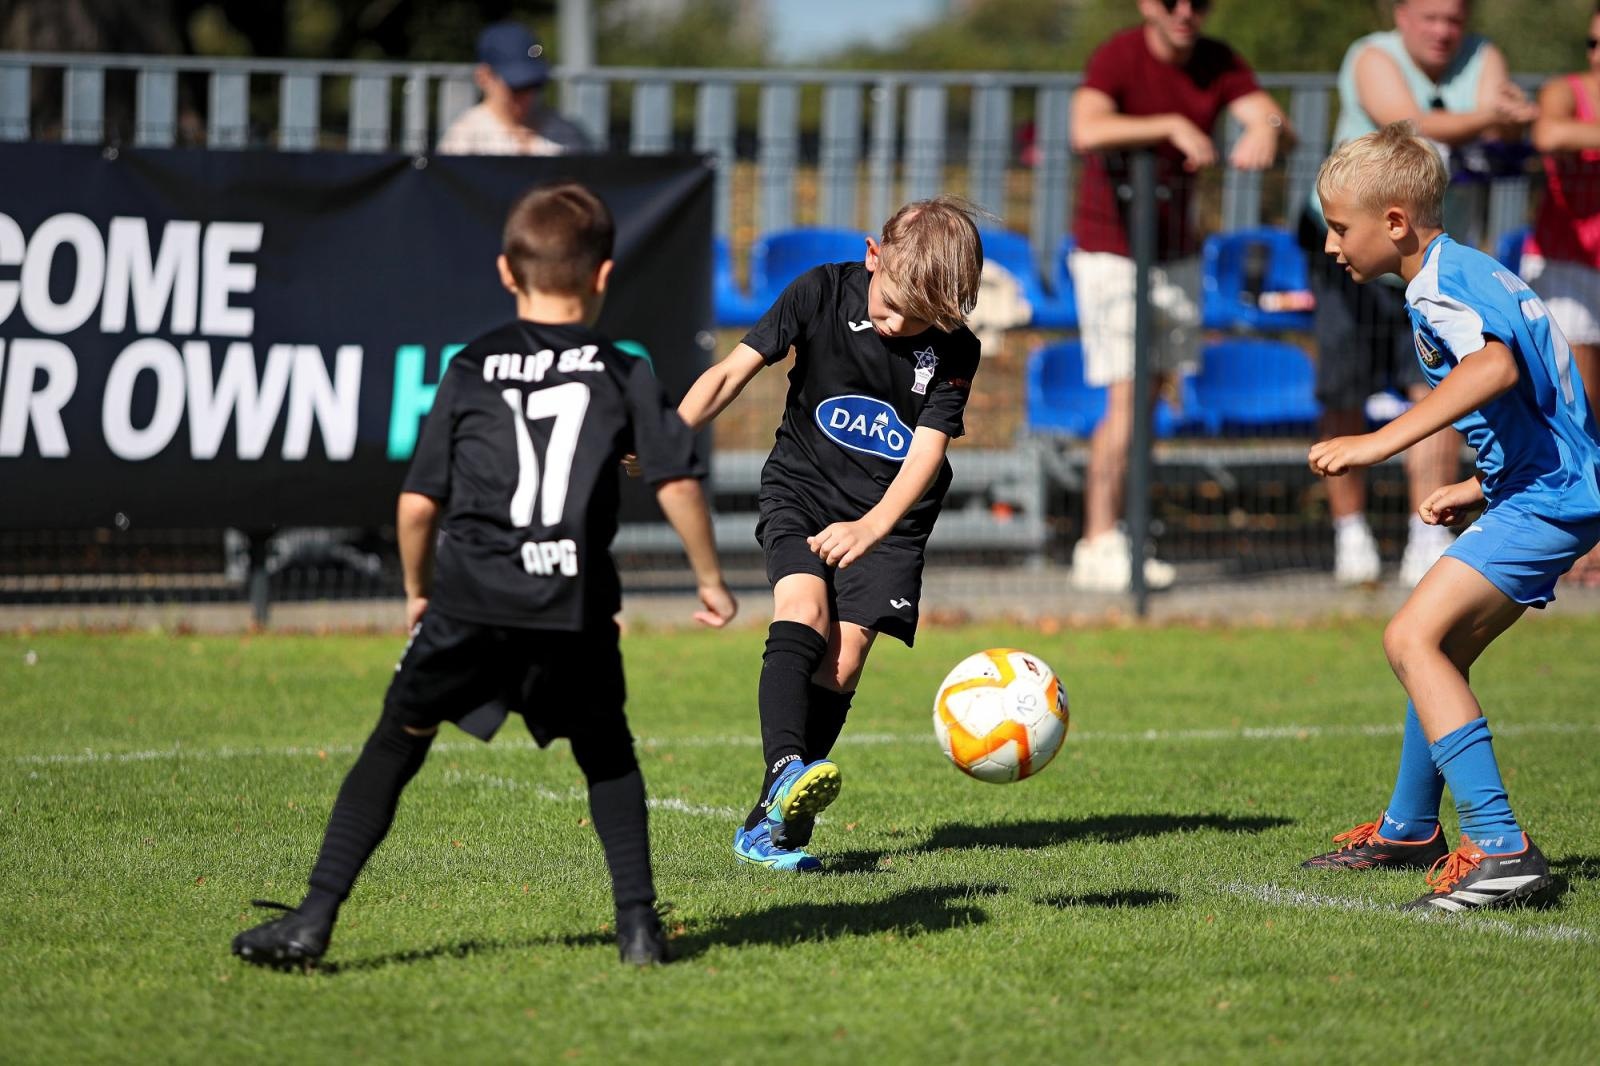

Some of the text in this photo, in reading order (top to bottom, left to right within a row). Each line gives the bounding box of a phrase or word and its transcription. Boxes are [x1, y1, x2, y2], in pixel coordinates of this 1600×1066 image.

[483, 344, 606, 382] FILIP SZ.
[0, 338, 78, 457] R
[103, 338, 364, 460] OWN
[829, 407, 905, 452] DAKO
[501, 381, 591, 528] 17
[520, 538, 578, 577] APG
[1016, 693, 1038, 717] 15
